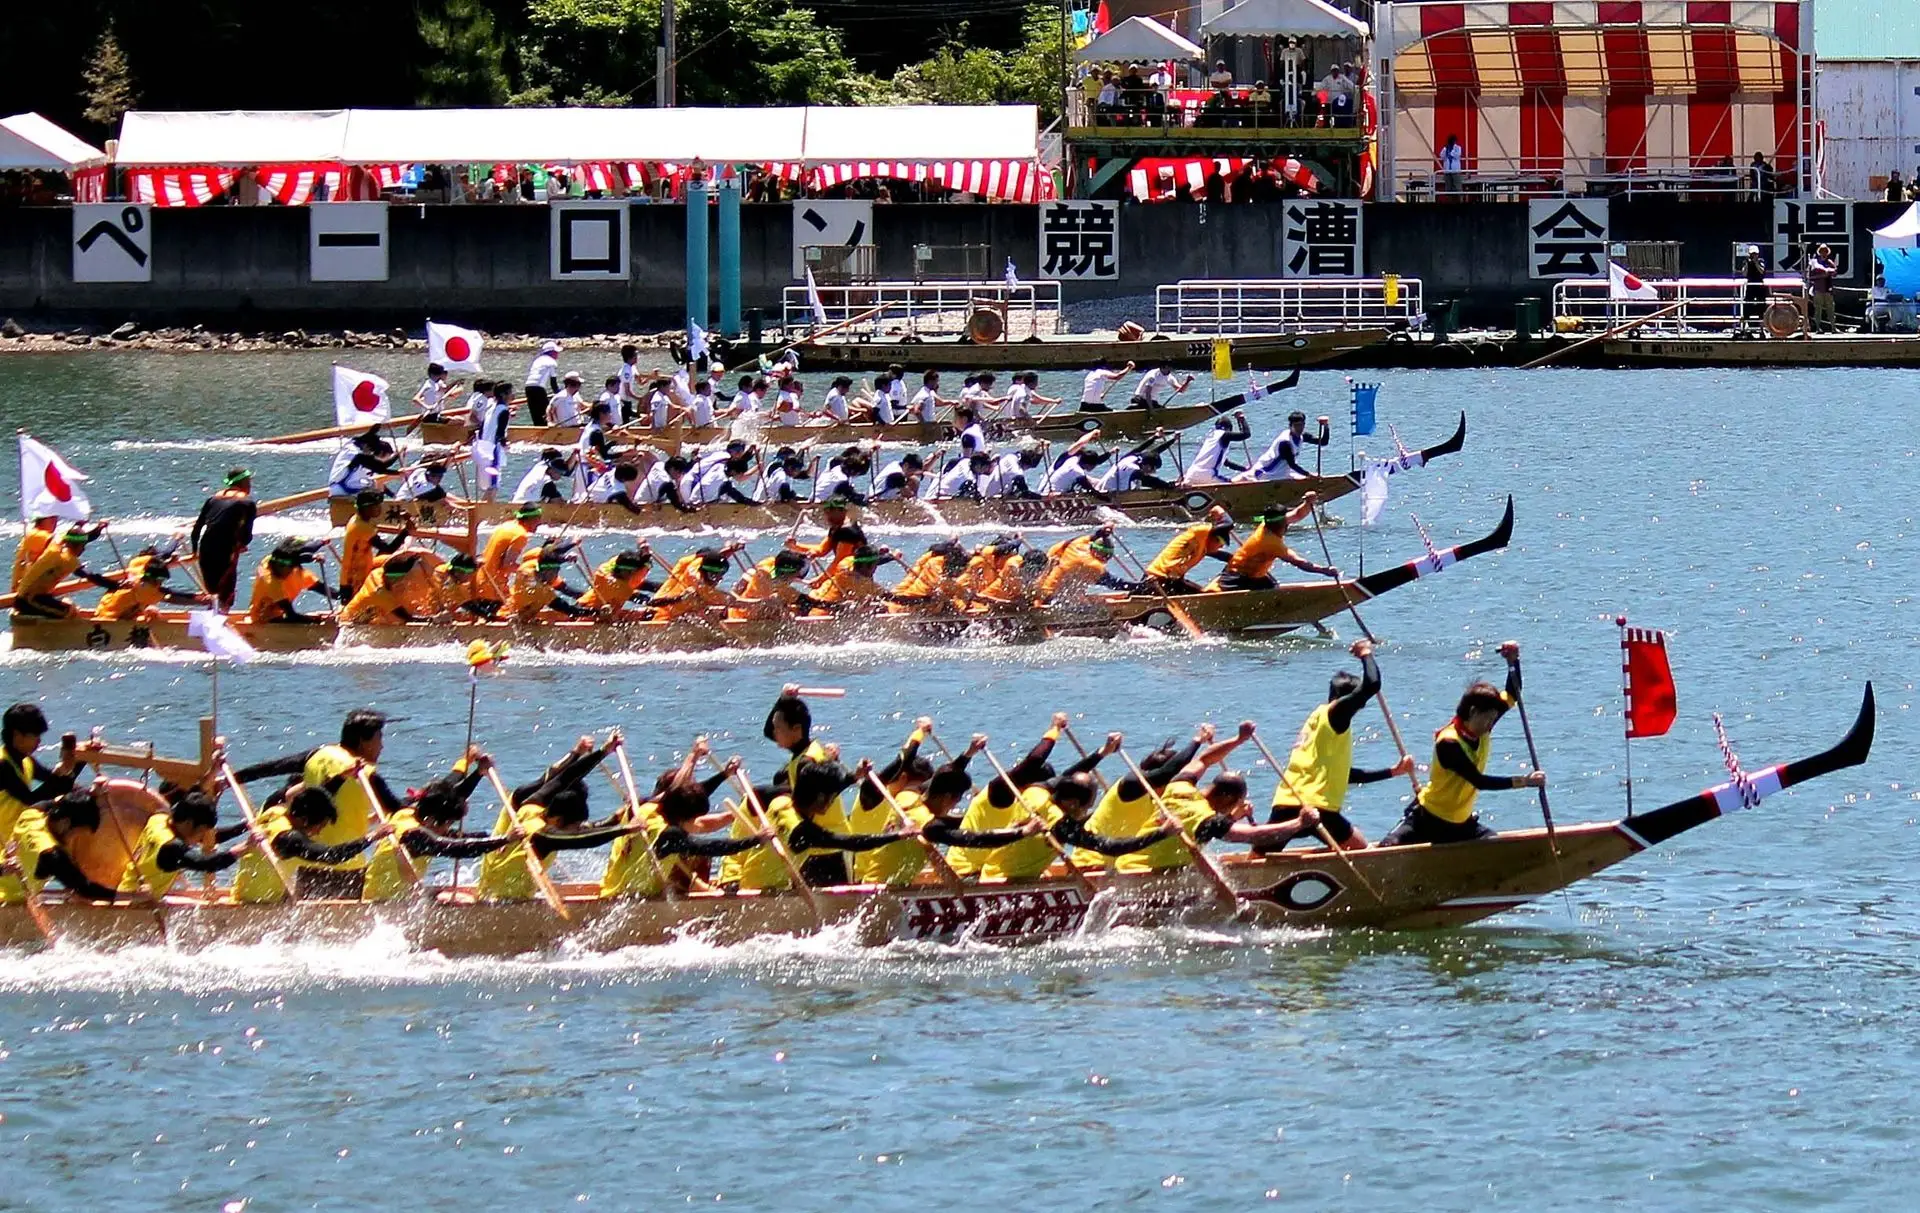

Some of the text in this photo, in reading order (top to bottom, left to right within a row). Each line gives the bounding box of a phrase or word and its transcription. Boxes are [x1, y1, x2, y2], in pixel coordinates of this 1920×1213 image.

[76, 206, 148, 268] ペ
[802, 208, 866, 265] ン
[1042, 202, 1116, 277] 競
[1286, 201, 1359, 276] 漕
[1532, 200, 1606, 276] 会
[1777, 202, 1850, 276] 場
